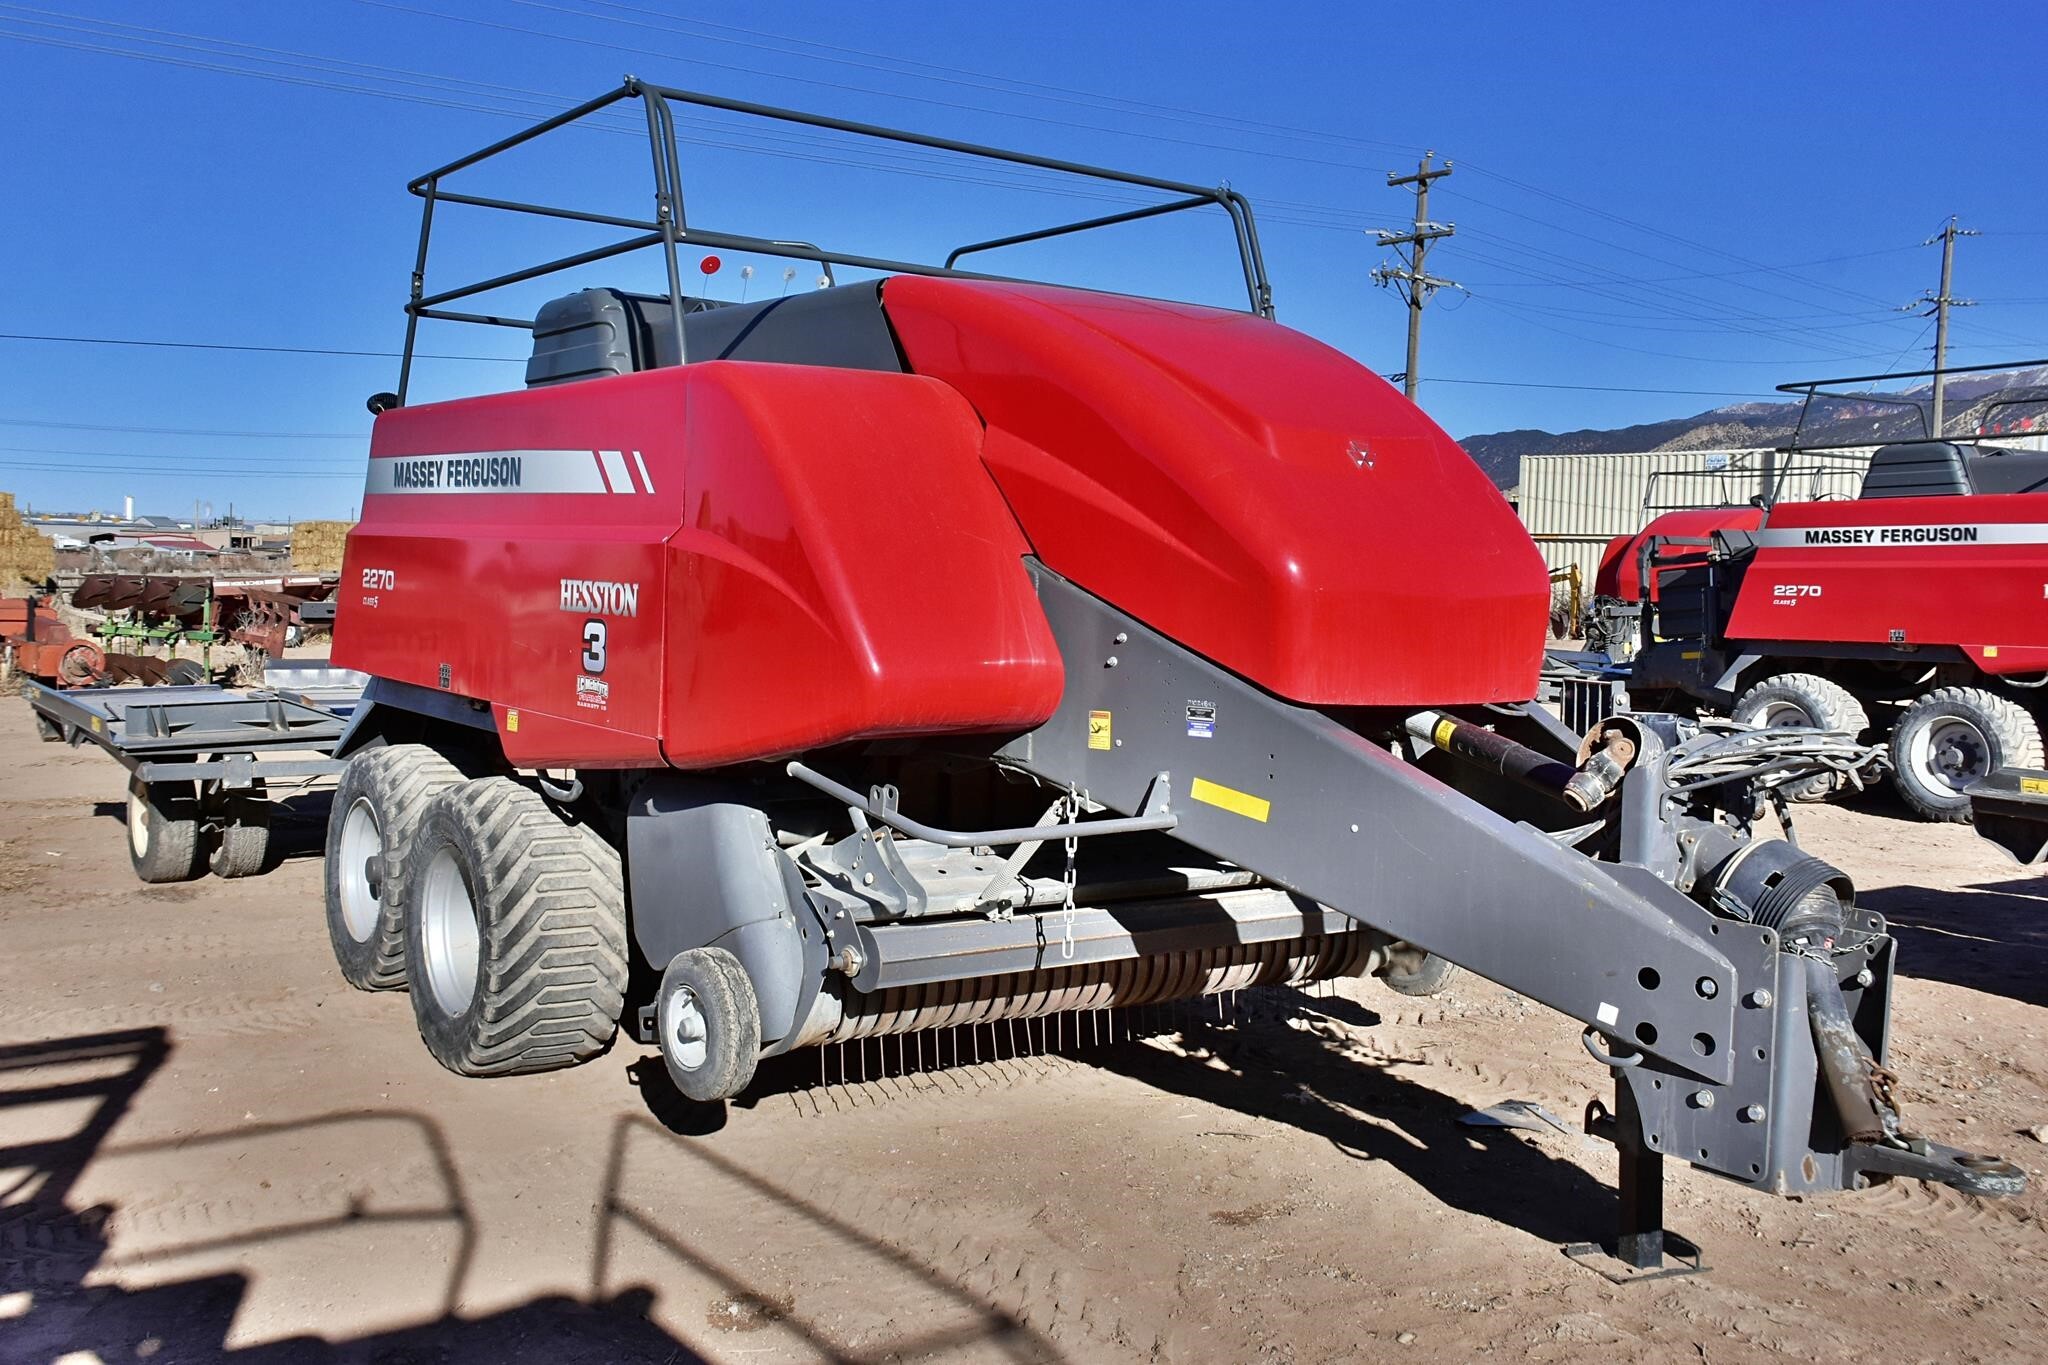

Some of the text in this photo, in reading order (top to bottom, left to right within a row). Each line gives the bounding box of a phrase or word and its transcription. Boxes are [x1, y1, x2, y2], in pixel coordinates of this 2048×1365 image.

[394, 457, 521, 488] MASSEY FERGUSON
[1805, 527, 1978, 544] MASSEY FERGUSON
[362, 568, 395, 590] 2270
[1773, 585, 1822, 597] 2270
[560, 578, 639, 617] HESSTON
[582, 618, 607, 676] 3
